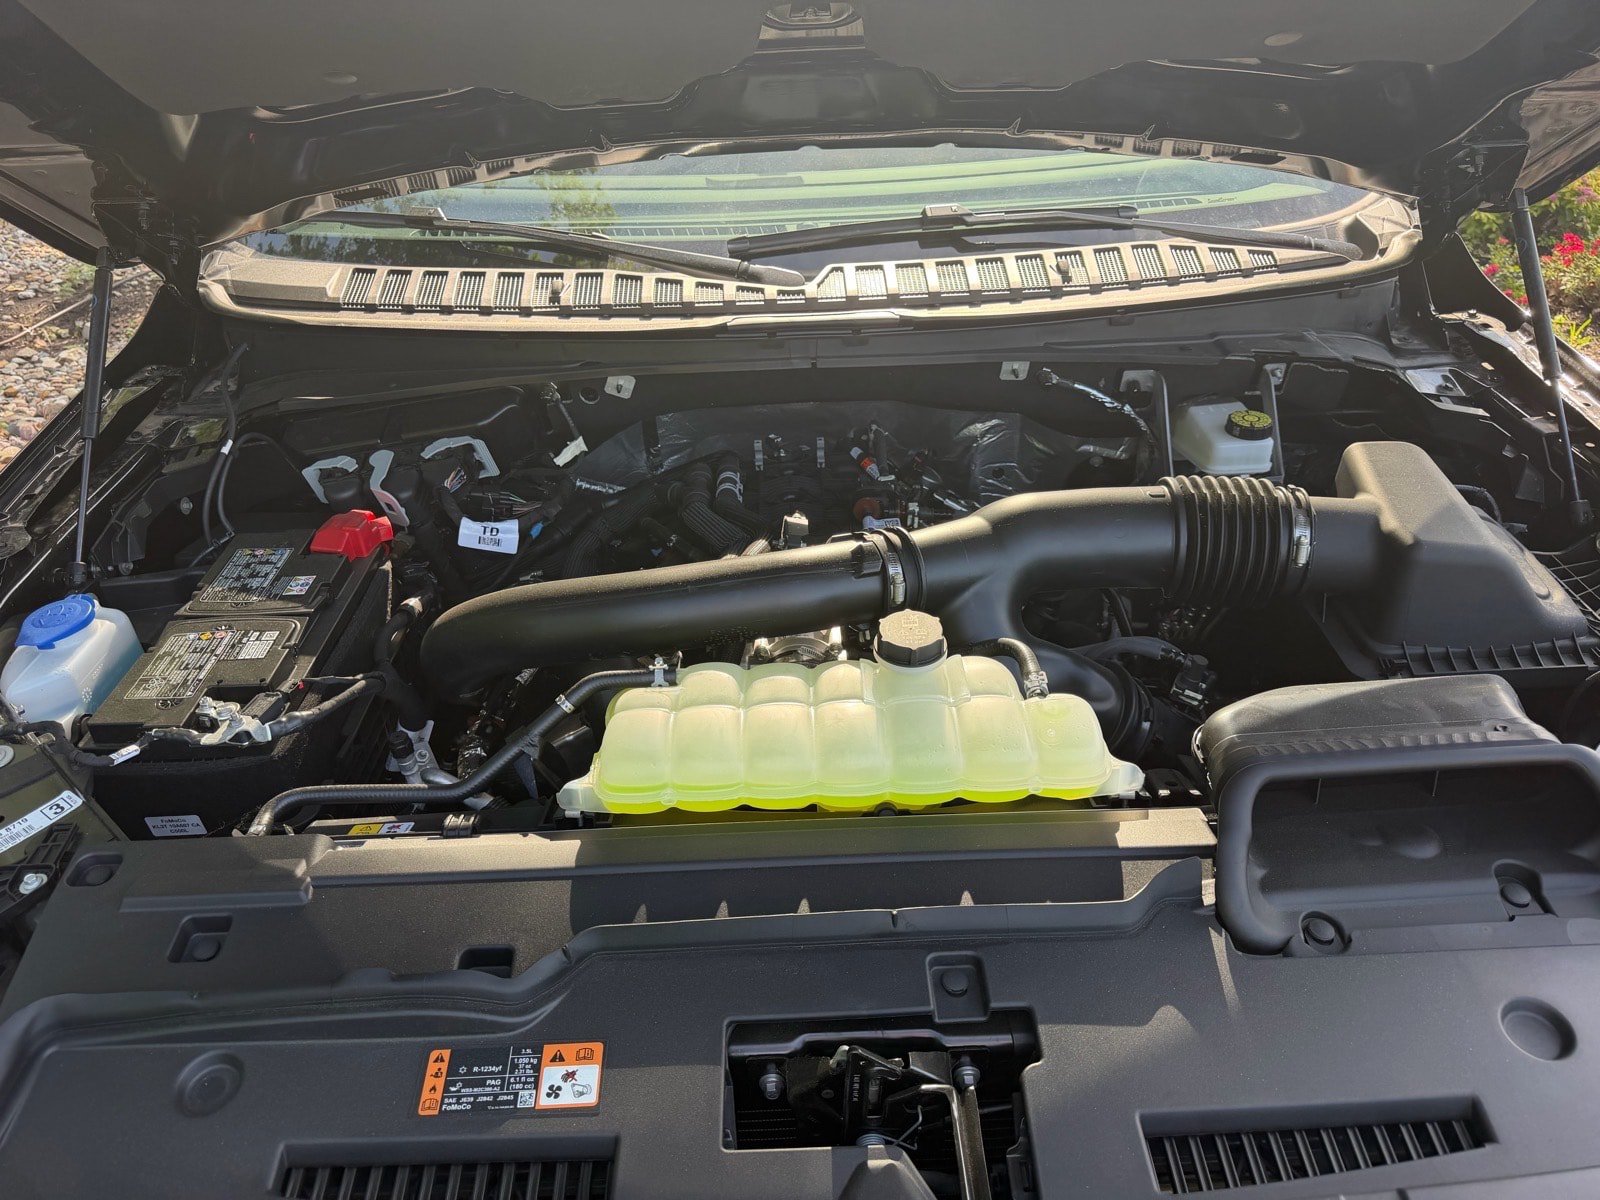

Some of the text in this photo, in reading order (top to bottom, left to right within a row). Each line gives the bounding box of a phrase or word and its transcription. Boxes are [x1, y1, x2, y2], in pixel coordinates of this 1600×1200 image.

[480, 526, 500, 537] TD
[48, 803, 66, 815] 3
[472, 1065, 503, 1073] R-1234yf
